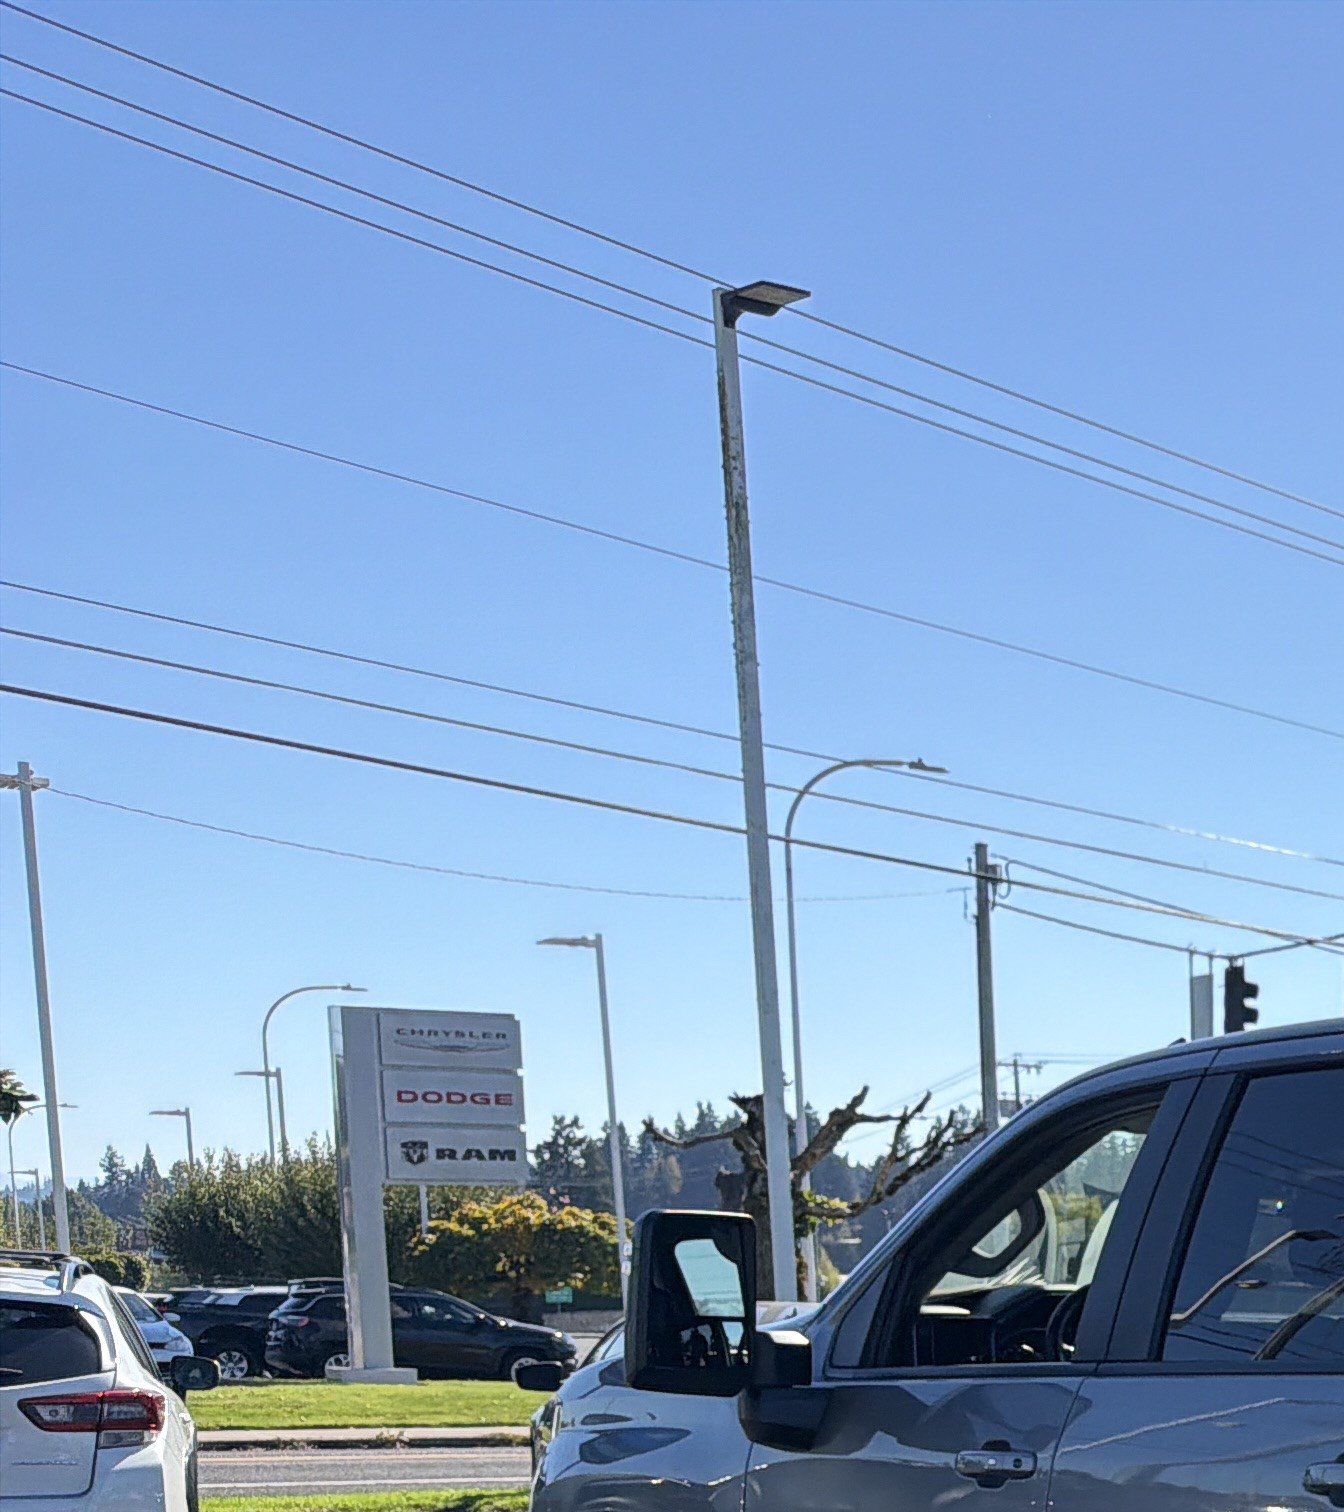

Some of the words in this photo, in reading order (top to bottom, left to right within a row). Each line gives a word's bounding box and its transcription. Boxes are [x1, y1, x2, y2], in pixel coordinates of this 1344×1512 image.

[396, 1027, 508, 1040] CHRYSLER
[396, 1090, 514, 1107] DODGE
[435, 1148, 517, 1162] RAM
